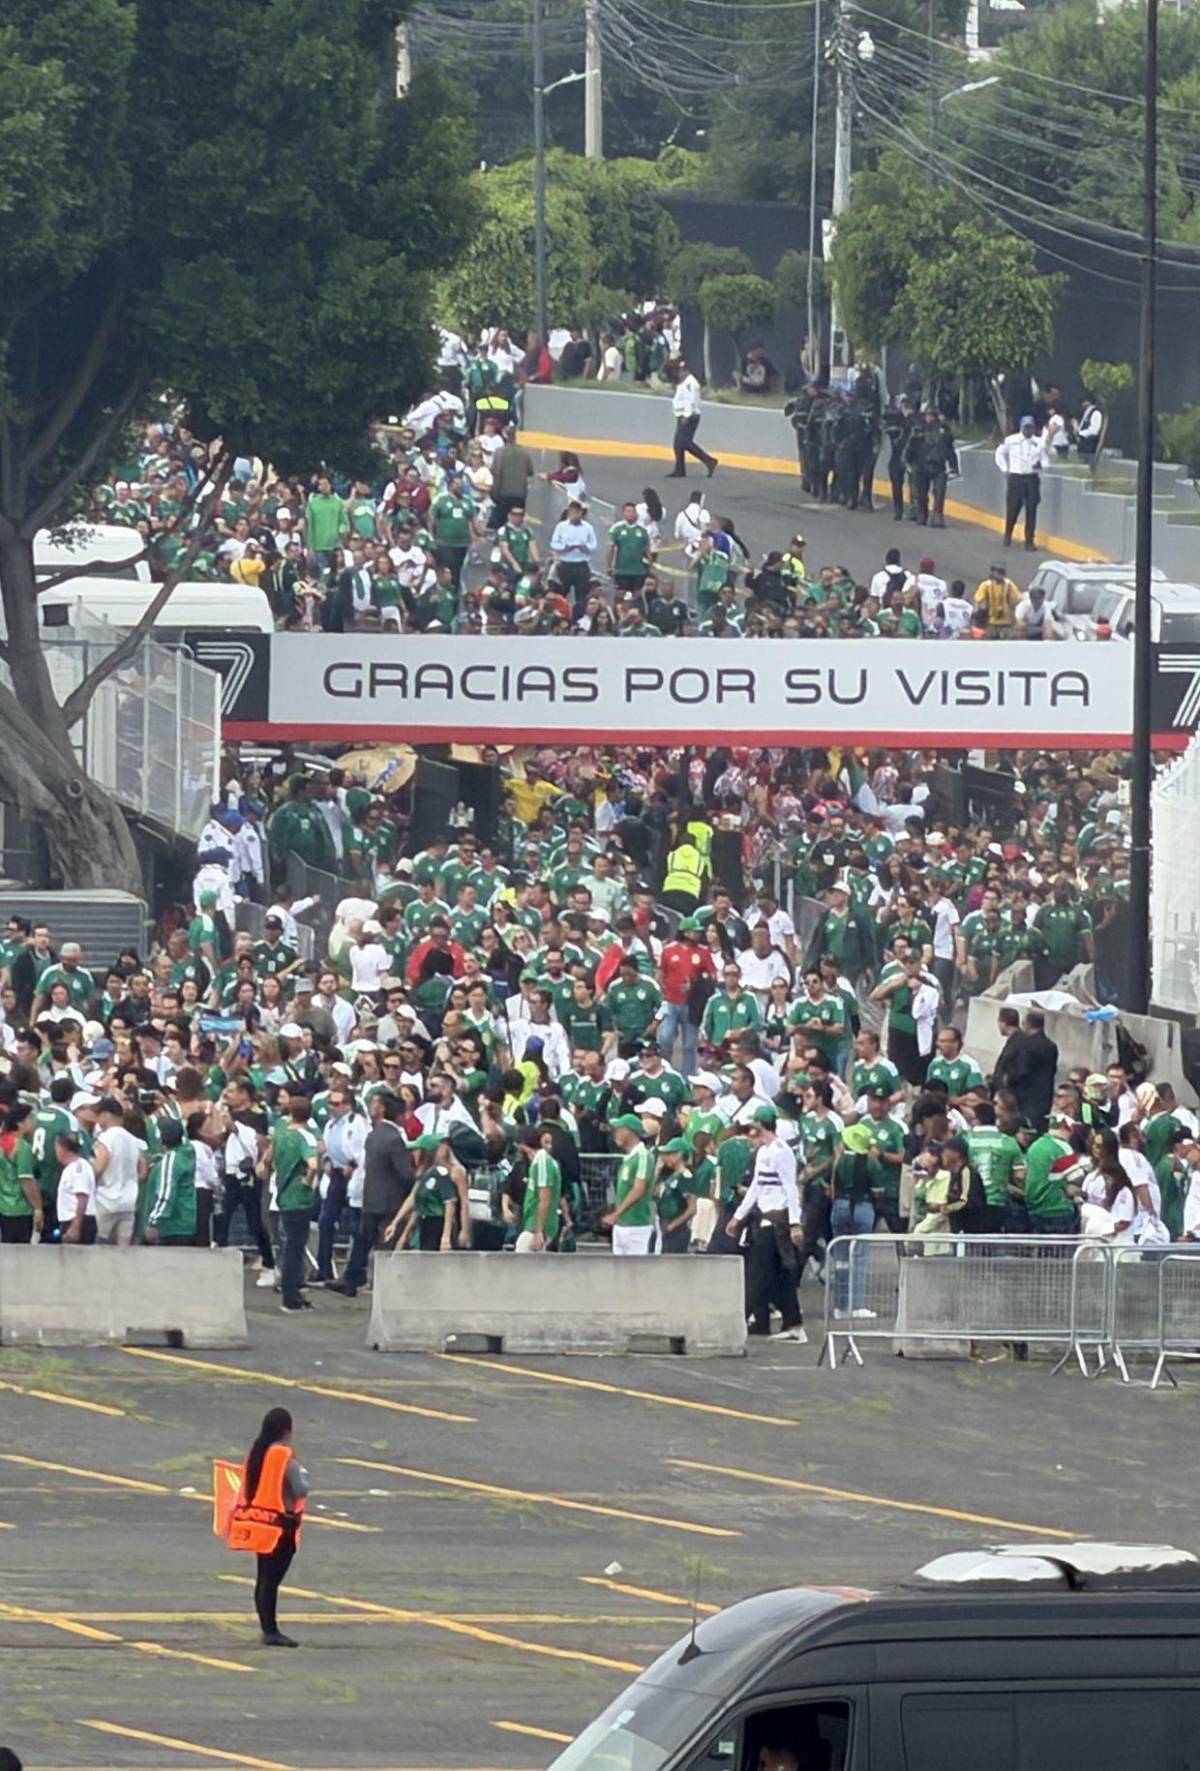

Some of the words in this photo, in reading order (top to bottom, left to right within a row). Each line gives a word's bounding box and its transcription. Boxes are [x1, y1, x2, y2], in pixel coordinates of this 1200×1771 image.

[323, 662, 599, 702] GRACIAS
[625, 667, 755, 705] POR
[784, 668, 867, 705] SU
[895, 669, 1090, 707] VISITA
